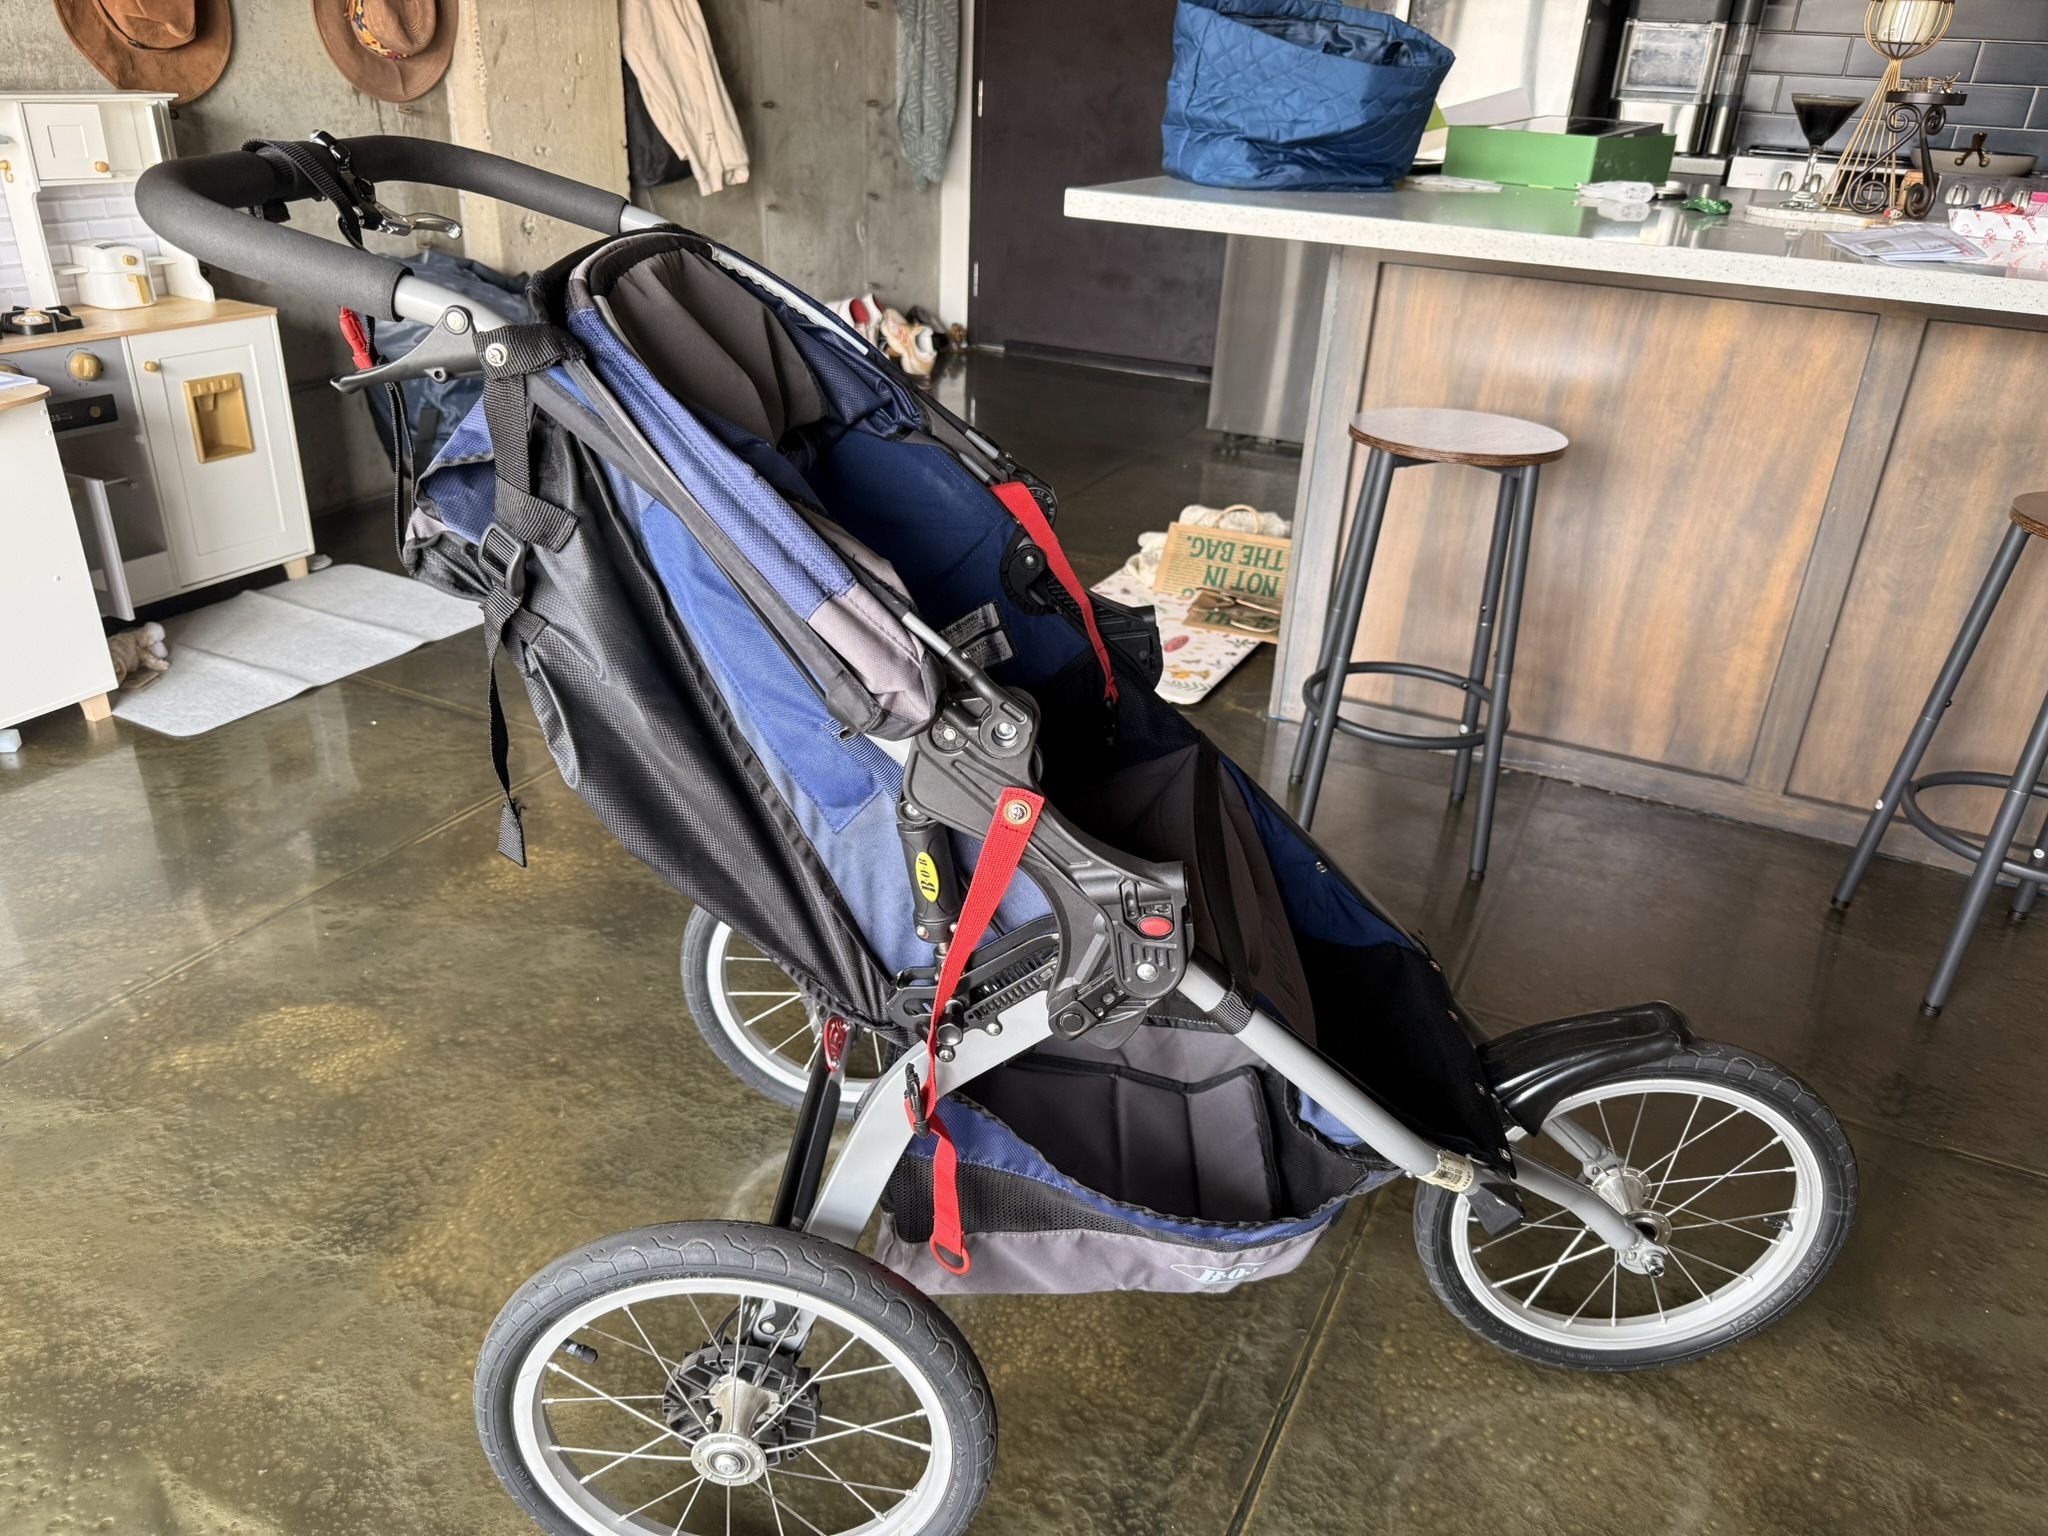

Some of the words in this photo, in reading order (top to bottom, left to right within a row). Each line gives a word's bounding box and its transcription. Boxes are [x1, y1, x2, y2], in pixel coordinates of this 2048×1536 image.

[1186, 535, 1236, 564] BAG.
[1239, 544, 1285, 572] THE
[1202, 565, 1230, 588] IN
[1230, 571, 1281, 598] NOT
[944, 613, 979, 638] WARNING
